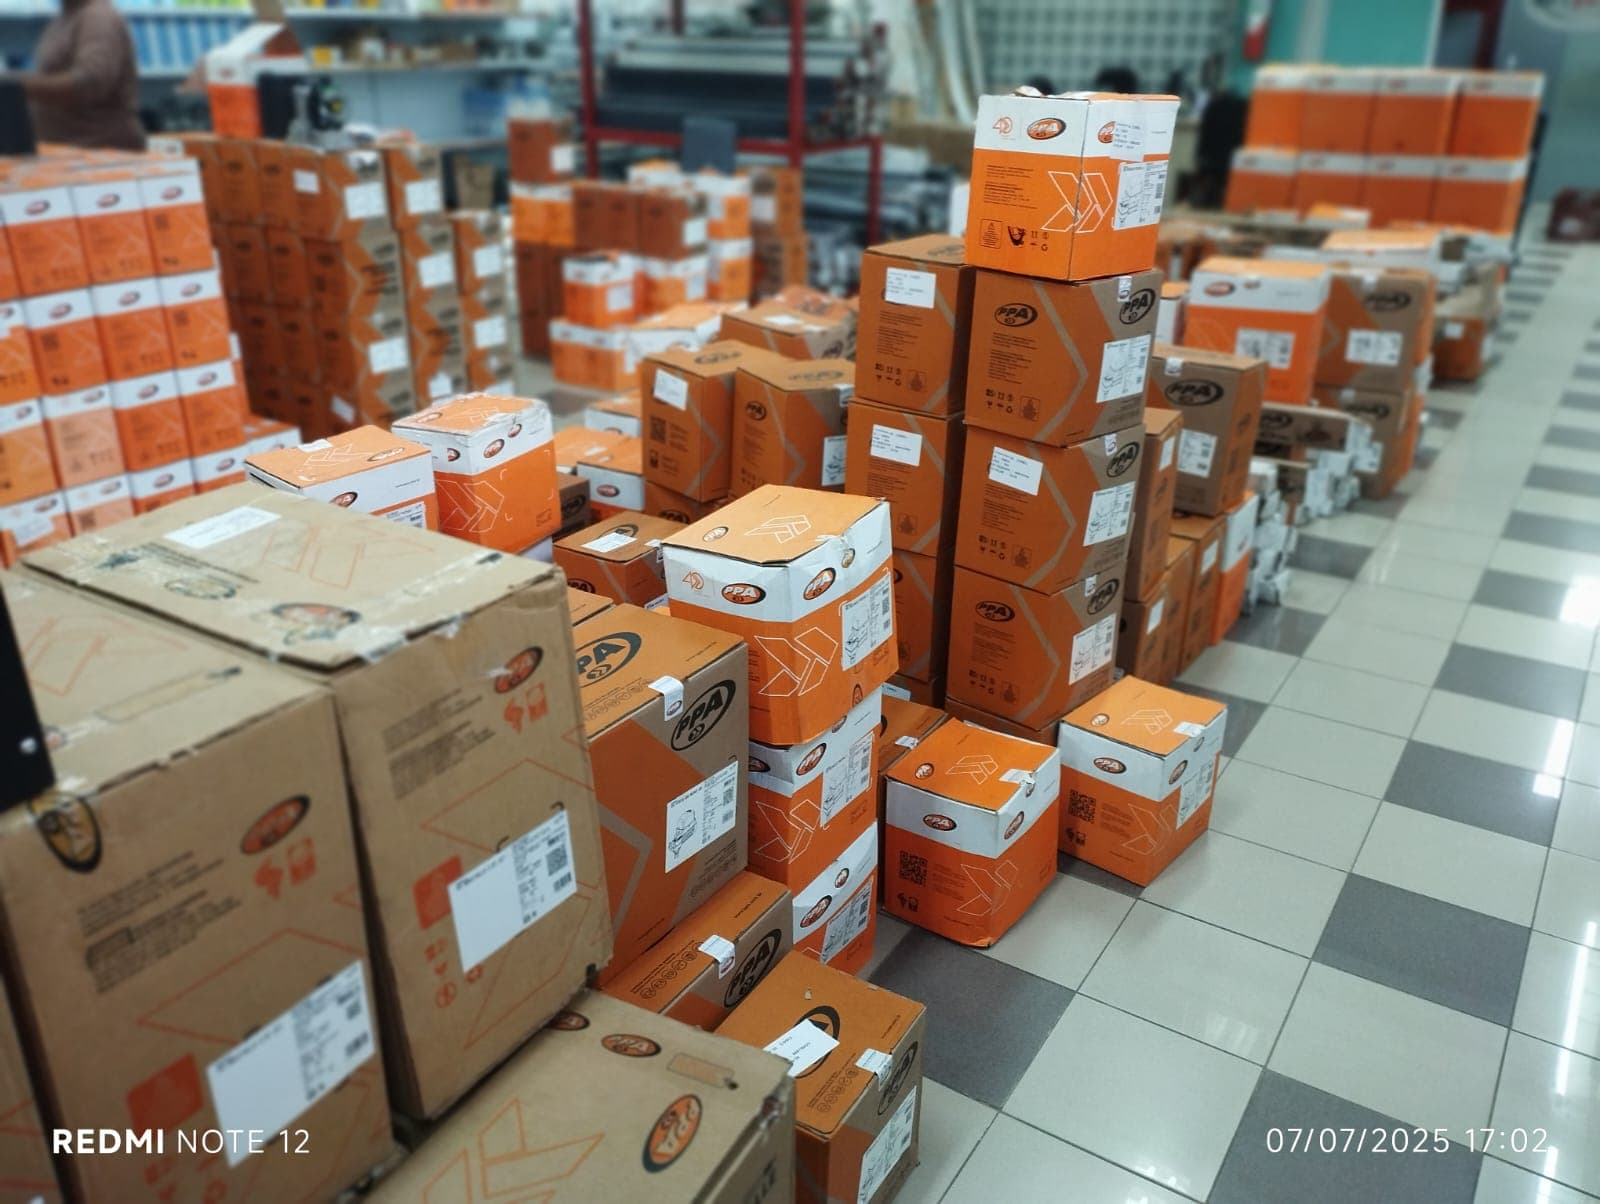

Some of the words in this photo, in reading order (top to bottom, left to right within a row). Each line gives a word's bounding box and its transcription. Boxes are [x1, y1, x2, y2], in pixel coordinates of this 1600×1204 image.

[1121, 293, 1149, 316] PPA
[997, 307, 1029, 321] PPA
[1167, 383, 1213, 398] PPA
[806, 571, 833, 593] PPA
[724, 586, 757, 598] PPA
[979, 602, 1008, 618] PPA
[577, 642, 627, 676] PA
[676, 689, 724, 740] PPA
[1094, 758, 1121, 770] PPA
[923, 815, 951, 829] PPA
[728, 941, 770, 999] PPA
